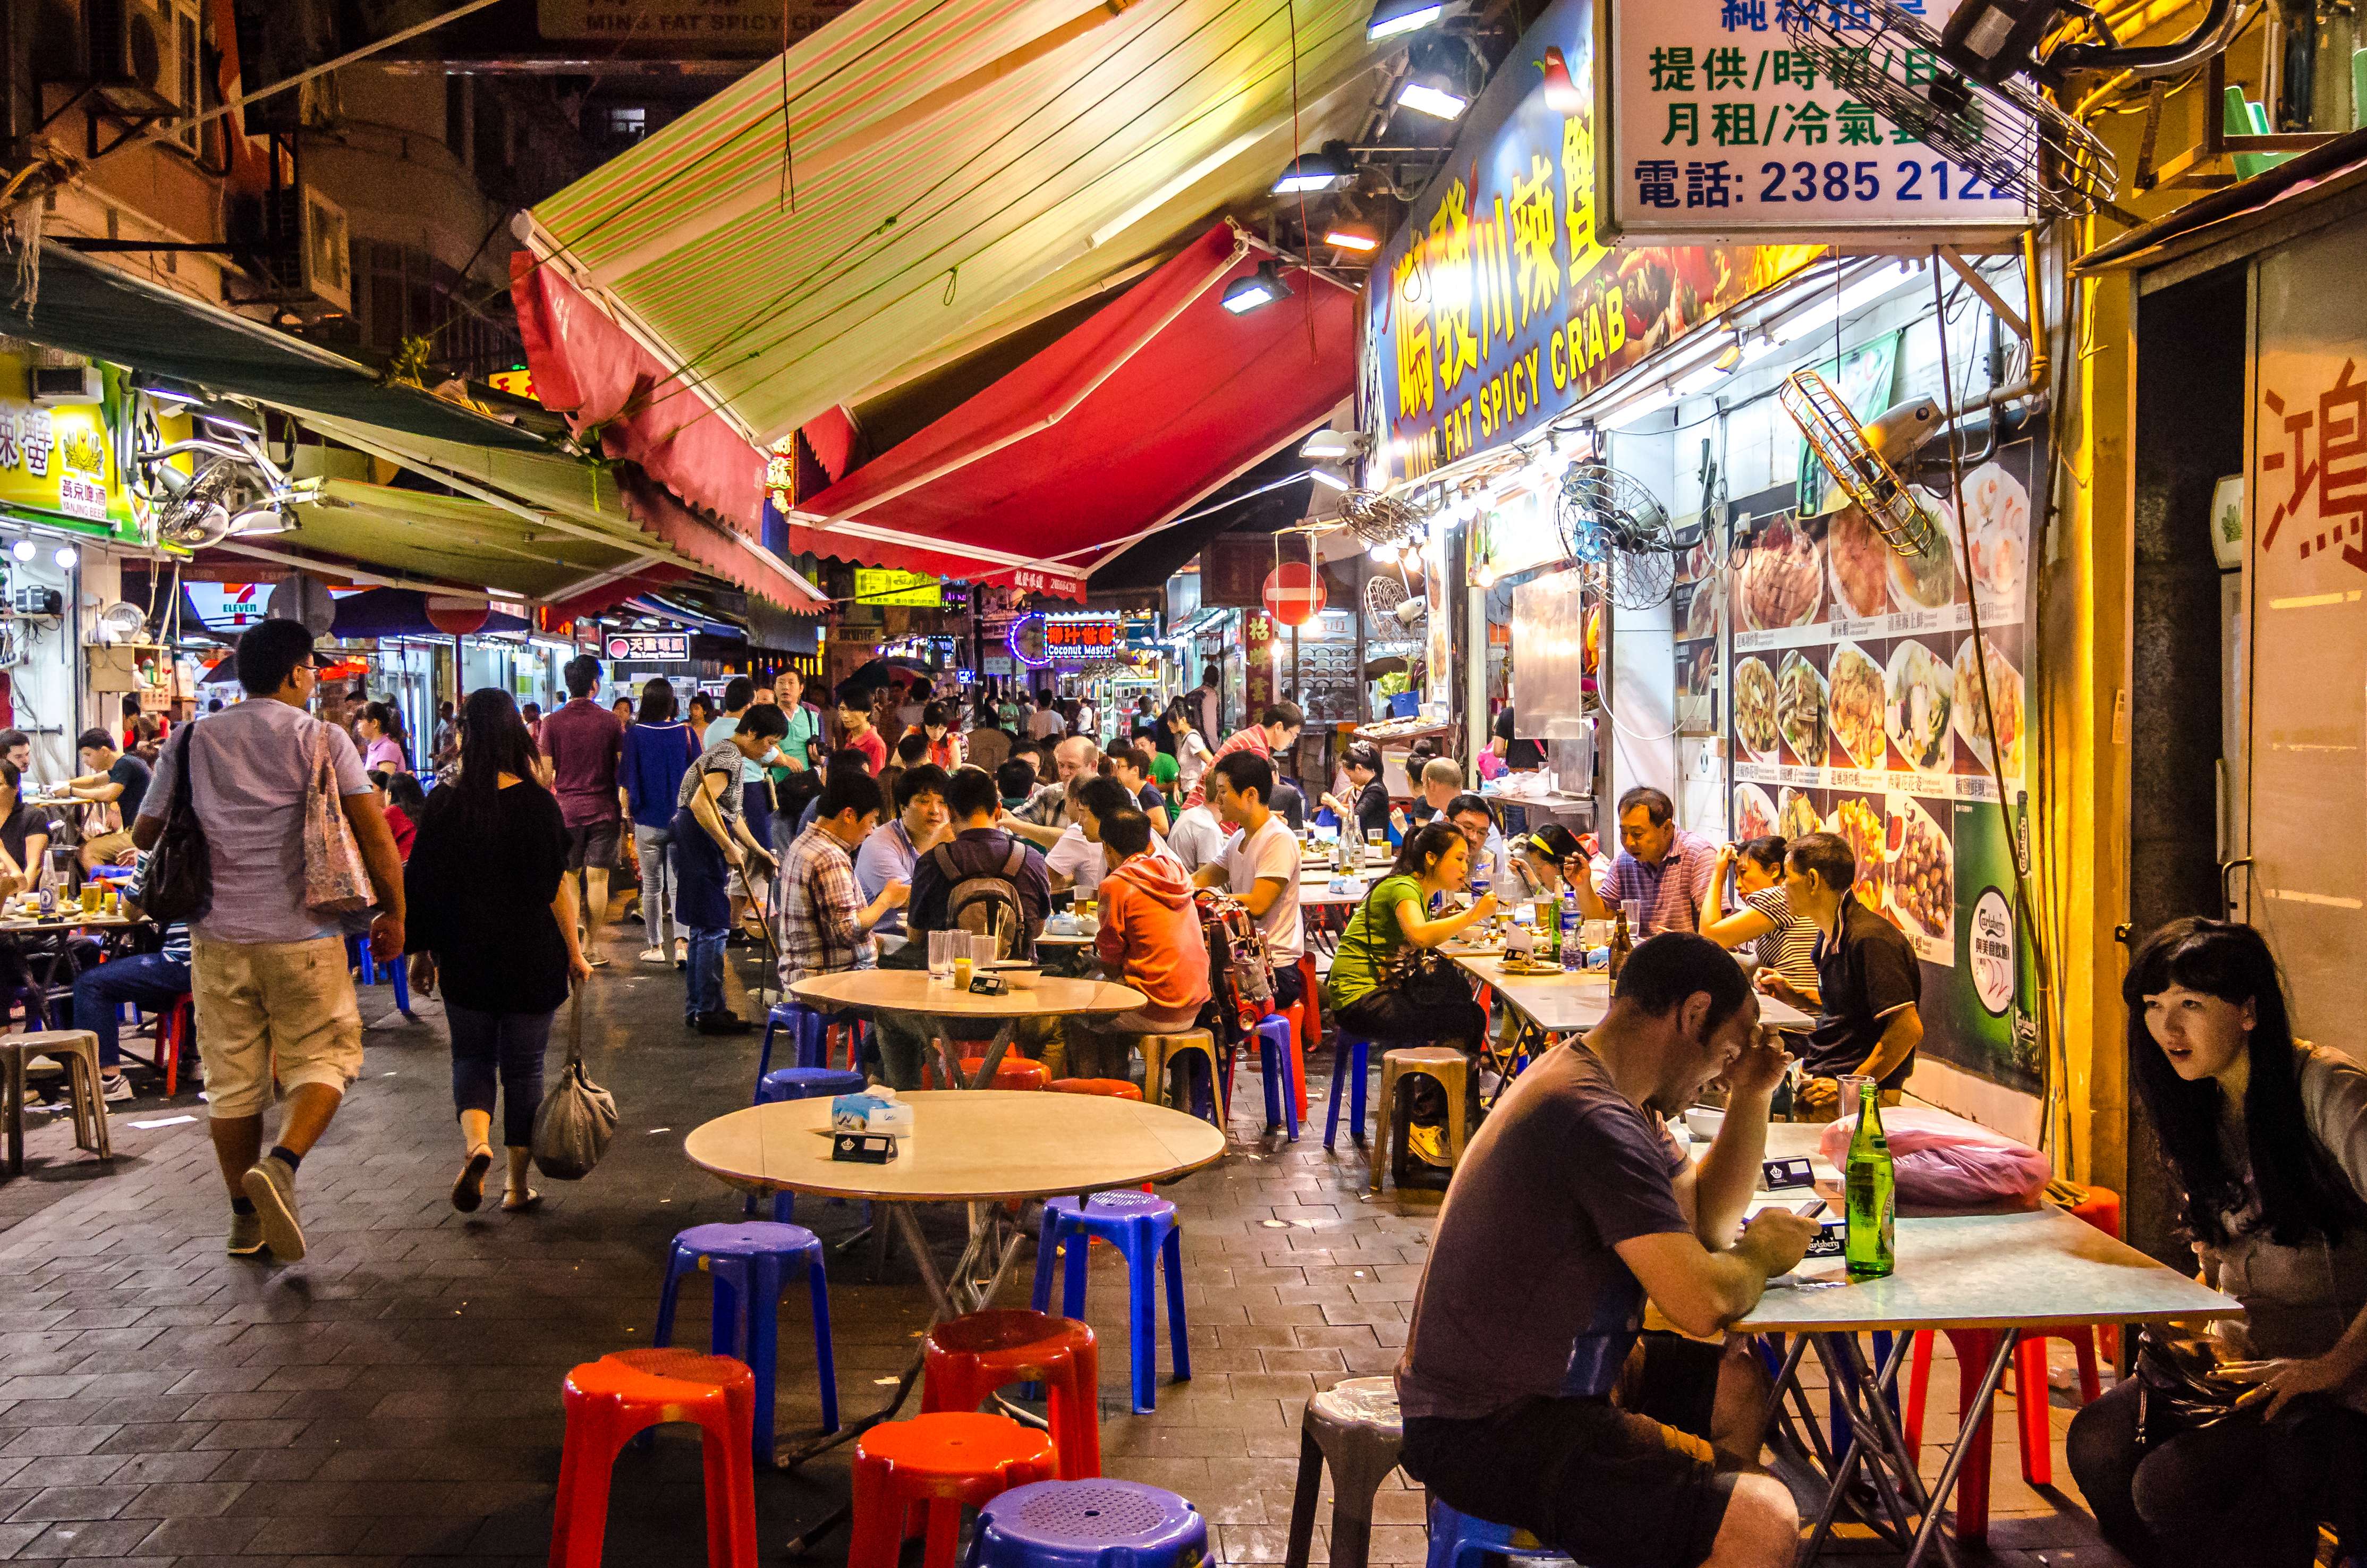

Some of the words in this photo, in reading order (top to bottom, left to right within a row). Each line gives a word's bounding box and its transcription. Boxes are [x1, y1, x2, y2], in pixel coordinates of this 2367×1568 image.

[660, 14, 701, 31] FAT
[711, 14, 783, 31] SPICY
[792, 14, 830, 31] CR
[1649, 47, 1981, 92] 提供/時租/日
[1634, 160, 1744, 208] 電話:
[1760, 161, 1880, 203] 2385
[1896, 160, 2017, 201] 2122
[1444, 399, 1473, 462] FAT
[1480, 347, 1539, 438] SPICY
[1549, 285, 1626, 391] CRAB
[63, 479, 106, 506] 燕京啤酒
[62, 501, 88, 516] YANJING
[89, 506, 106, 519] BEER
[1048, 645, 1082, 655] Coconut
[1084, 645, 1113, 655] Master
[1808, 1236, 1839, 1253] arlsberg
